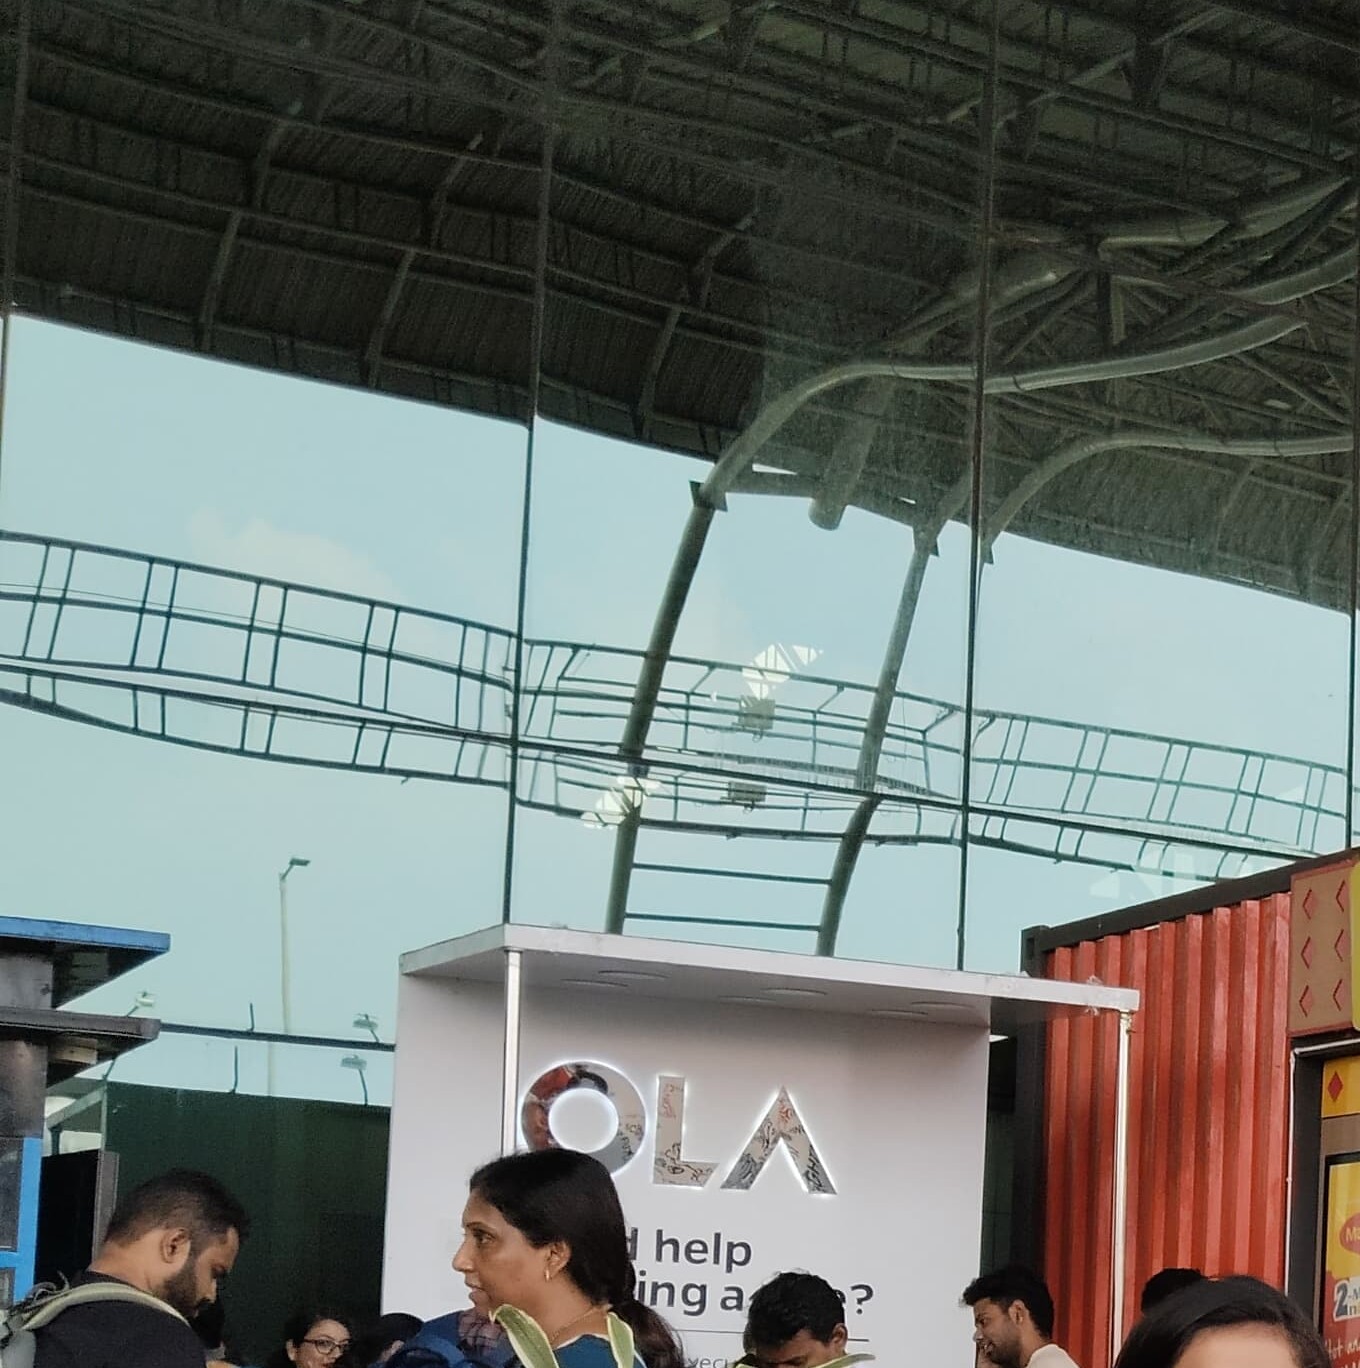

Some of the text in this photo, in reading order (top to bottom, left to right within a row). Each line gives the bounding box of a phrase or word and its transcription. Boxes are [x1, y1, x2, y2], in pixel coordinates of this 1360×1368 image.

[521, 1060, 837, 1195] OLA
[655, 1229, 752, 1273] help
[720, 1285, 744, 1312] a
